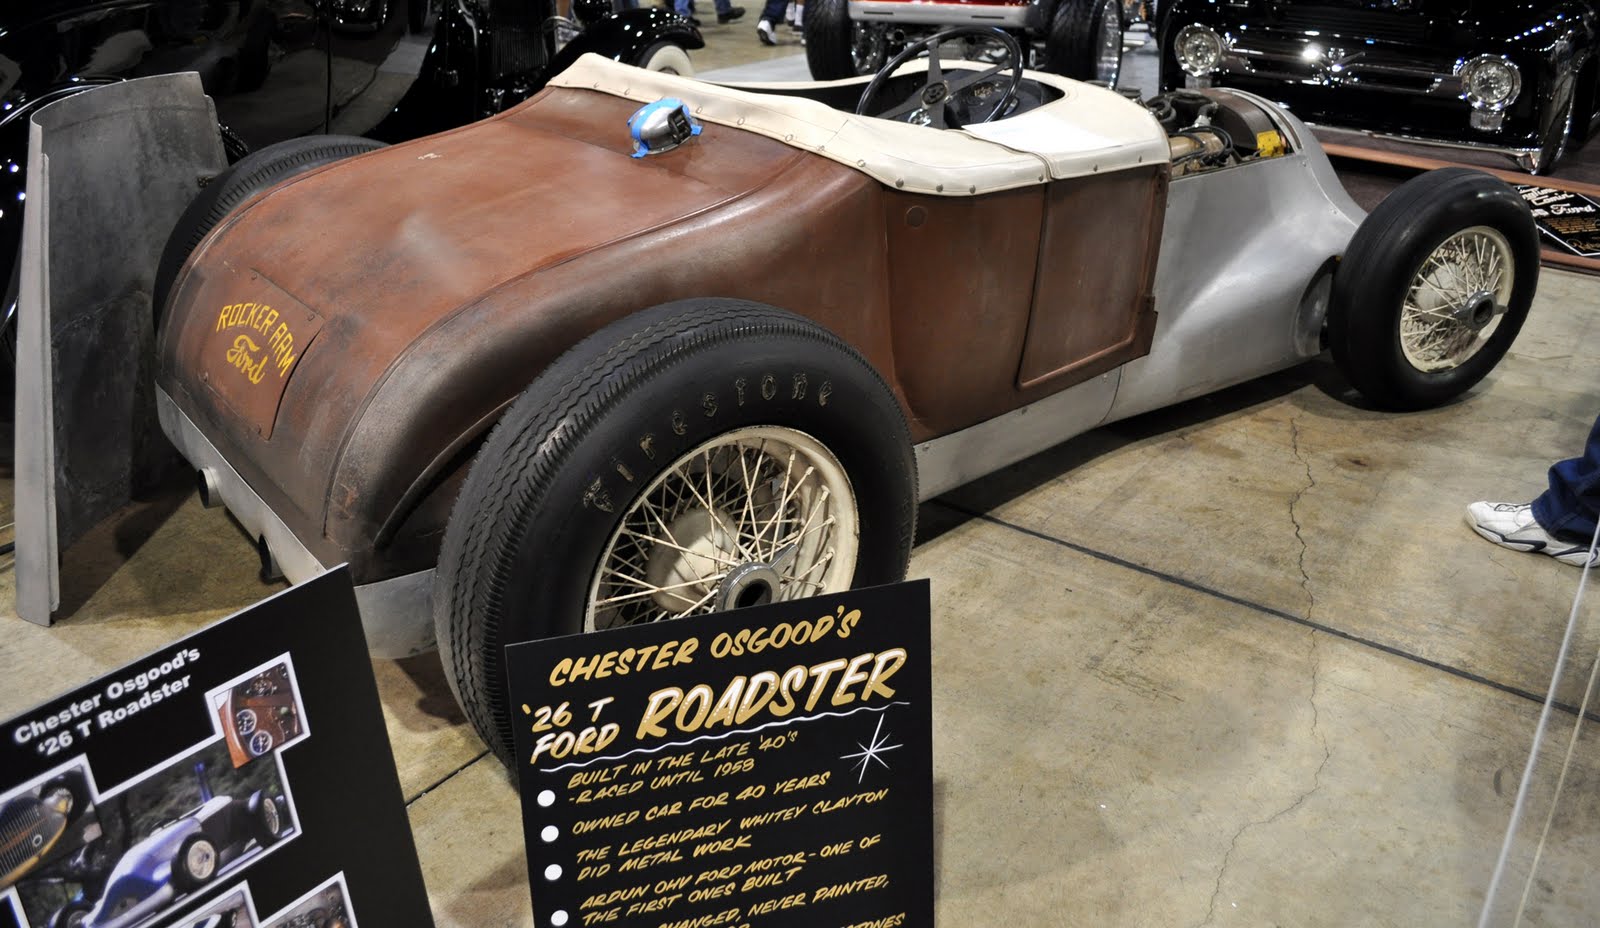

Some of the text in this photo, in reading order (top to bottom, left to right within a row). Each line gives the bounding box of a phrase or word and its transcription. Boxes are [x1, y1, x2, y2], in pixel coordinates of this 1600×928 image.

[215, 303, 297, 378] ROCKER ARM
[226, 334, 266, 385] Ford
[549, 605, 862, 687] CHESTER OSGOOD'S
[14, 647, 201, 744] Chester Osgood's
[76, 719, 93, 738] T
[98, 674, 191, 729] Roadster
[588, 696, 615, 723] T
[635, 647, 907, 740] ROADSTER
[530, 723, 620, 765] FORD
[567, 764, 628, 789] BUILT
[630, 760, 652, 776] IN
[657, 752, 695, 771] THE
[700, 742, 751, 763] LATE
[650, 770, 705, 790] UNTIL
[713, 758, 755, 777] 1958
[572, 770, 831, 835] OWNED CAR FOR 40 YEARS
[576, 788, 889, 864] THE LEGENDARY WHITEY CLAYTON
[576, 834, 752, 882] DID METAL WORK
[579, 884, 651, 911] ARDUN
[654, 875, 693, 894] OHV
[695, 864, 743, 886] FORD
[859, 834, 881, 849] OF
[582, 866, 802, 927] THE FIRST ONES BUILT
[747, 893, 807, 917] NEVER
[812, 874, 889, 903] PAINTED,
